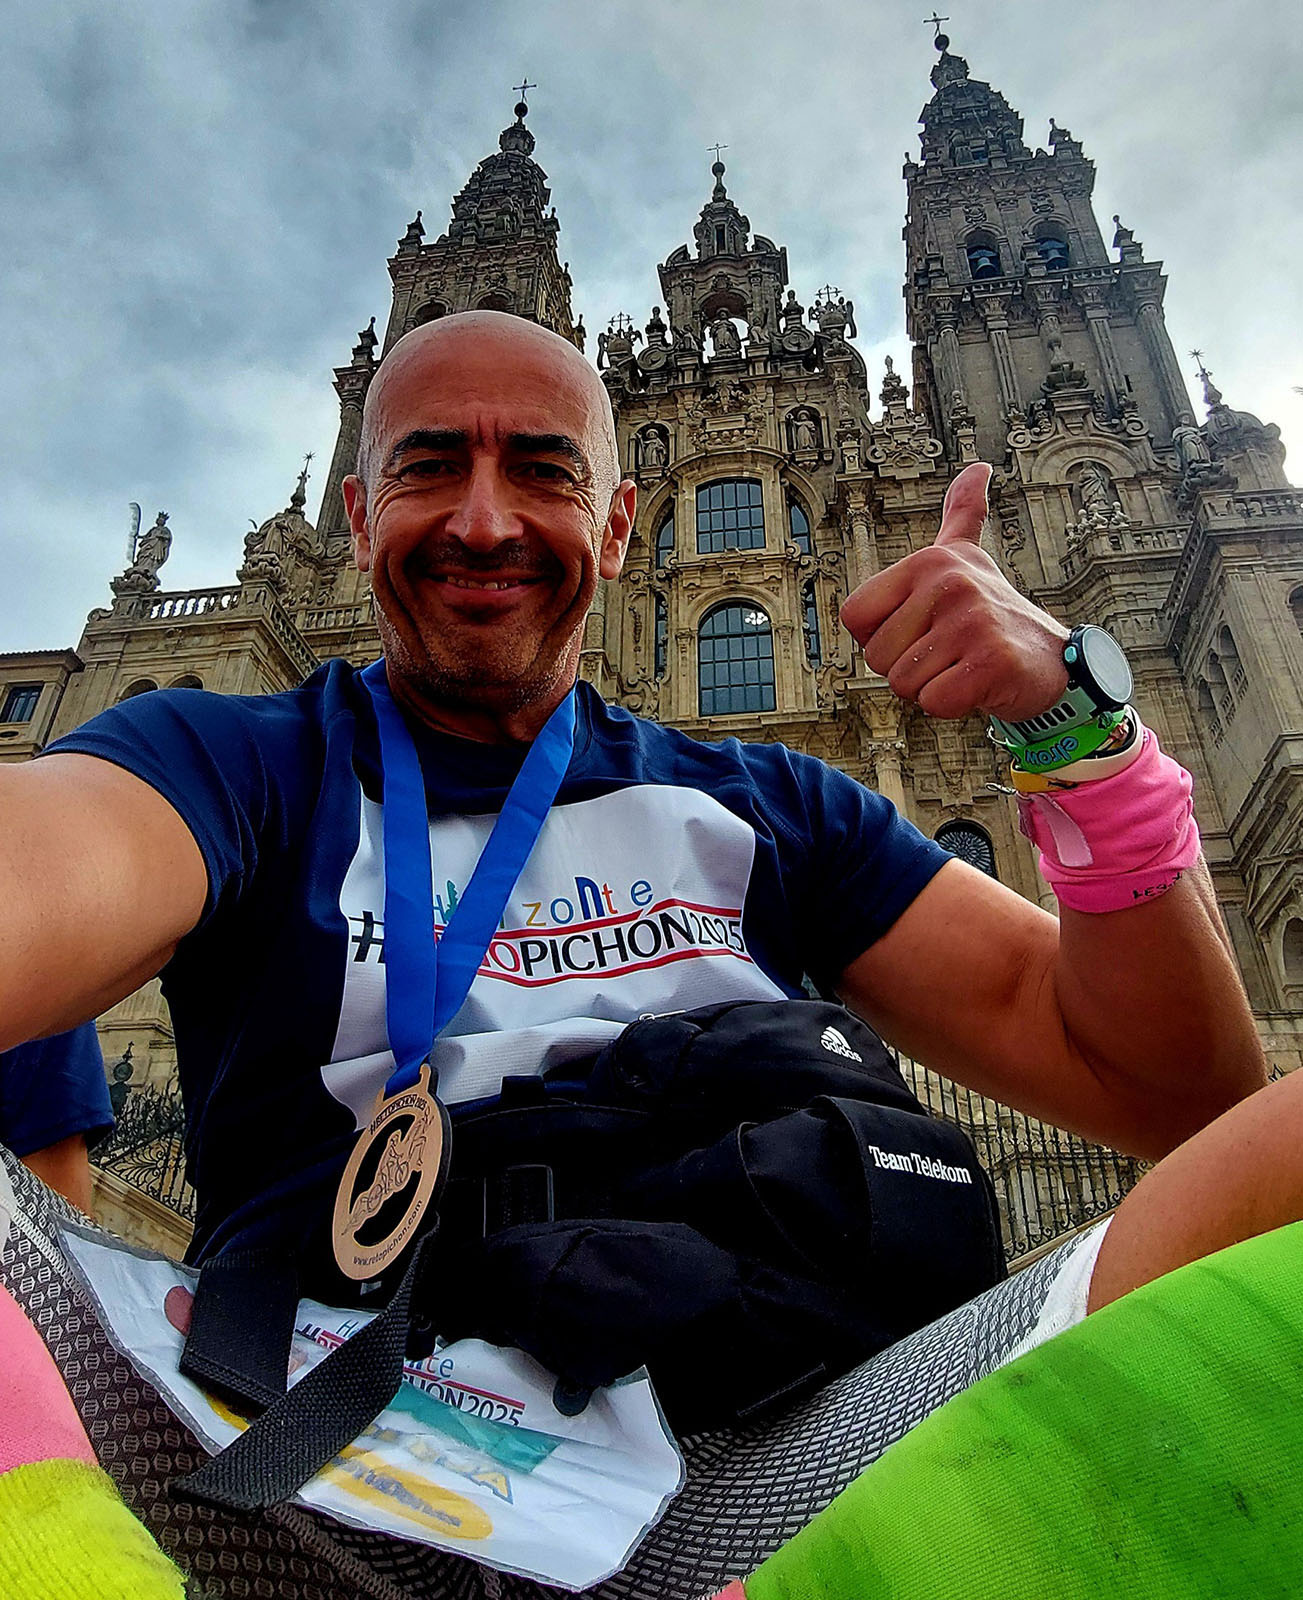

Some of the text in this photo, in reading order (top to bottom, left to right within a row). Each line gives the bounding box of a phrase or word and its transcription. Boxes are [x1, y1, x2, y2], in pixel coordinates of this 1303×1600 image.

[1025, 736, 1079, 766] elrow
[821, 1040, 862, 1063] adidas
[868, 1145, 972, 1184] Team Telekom
